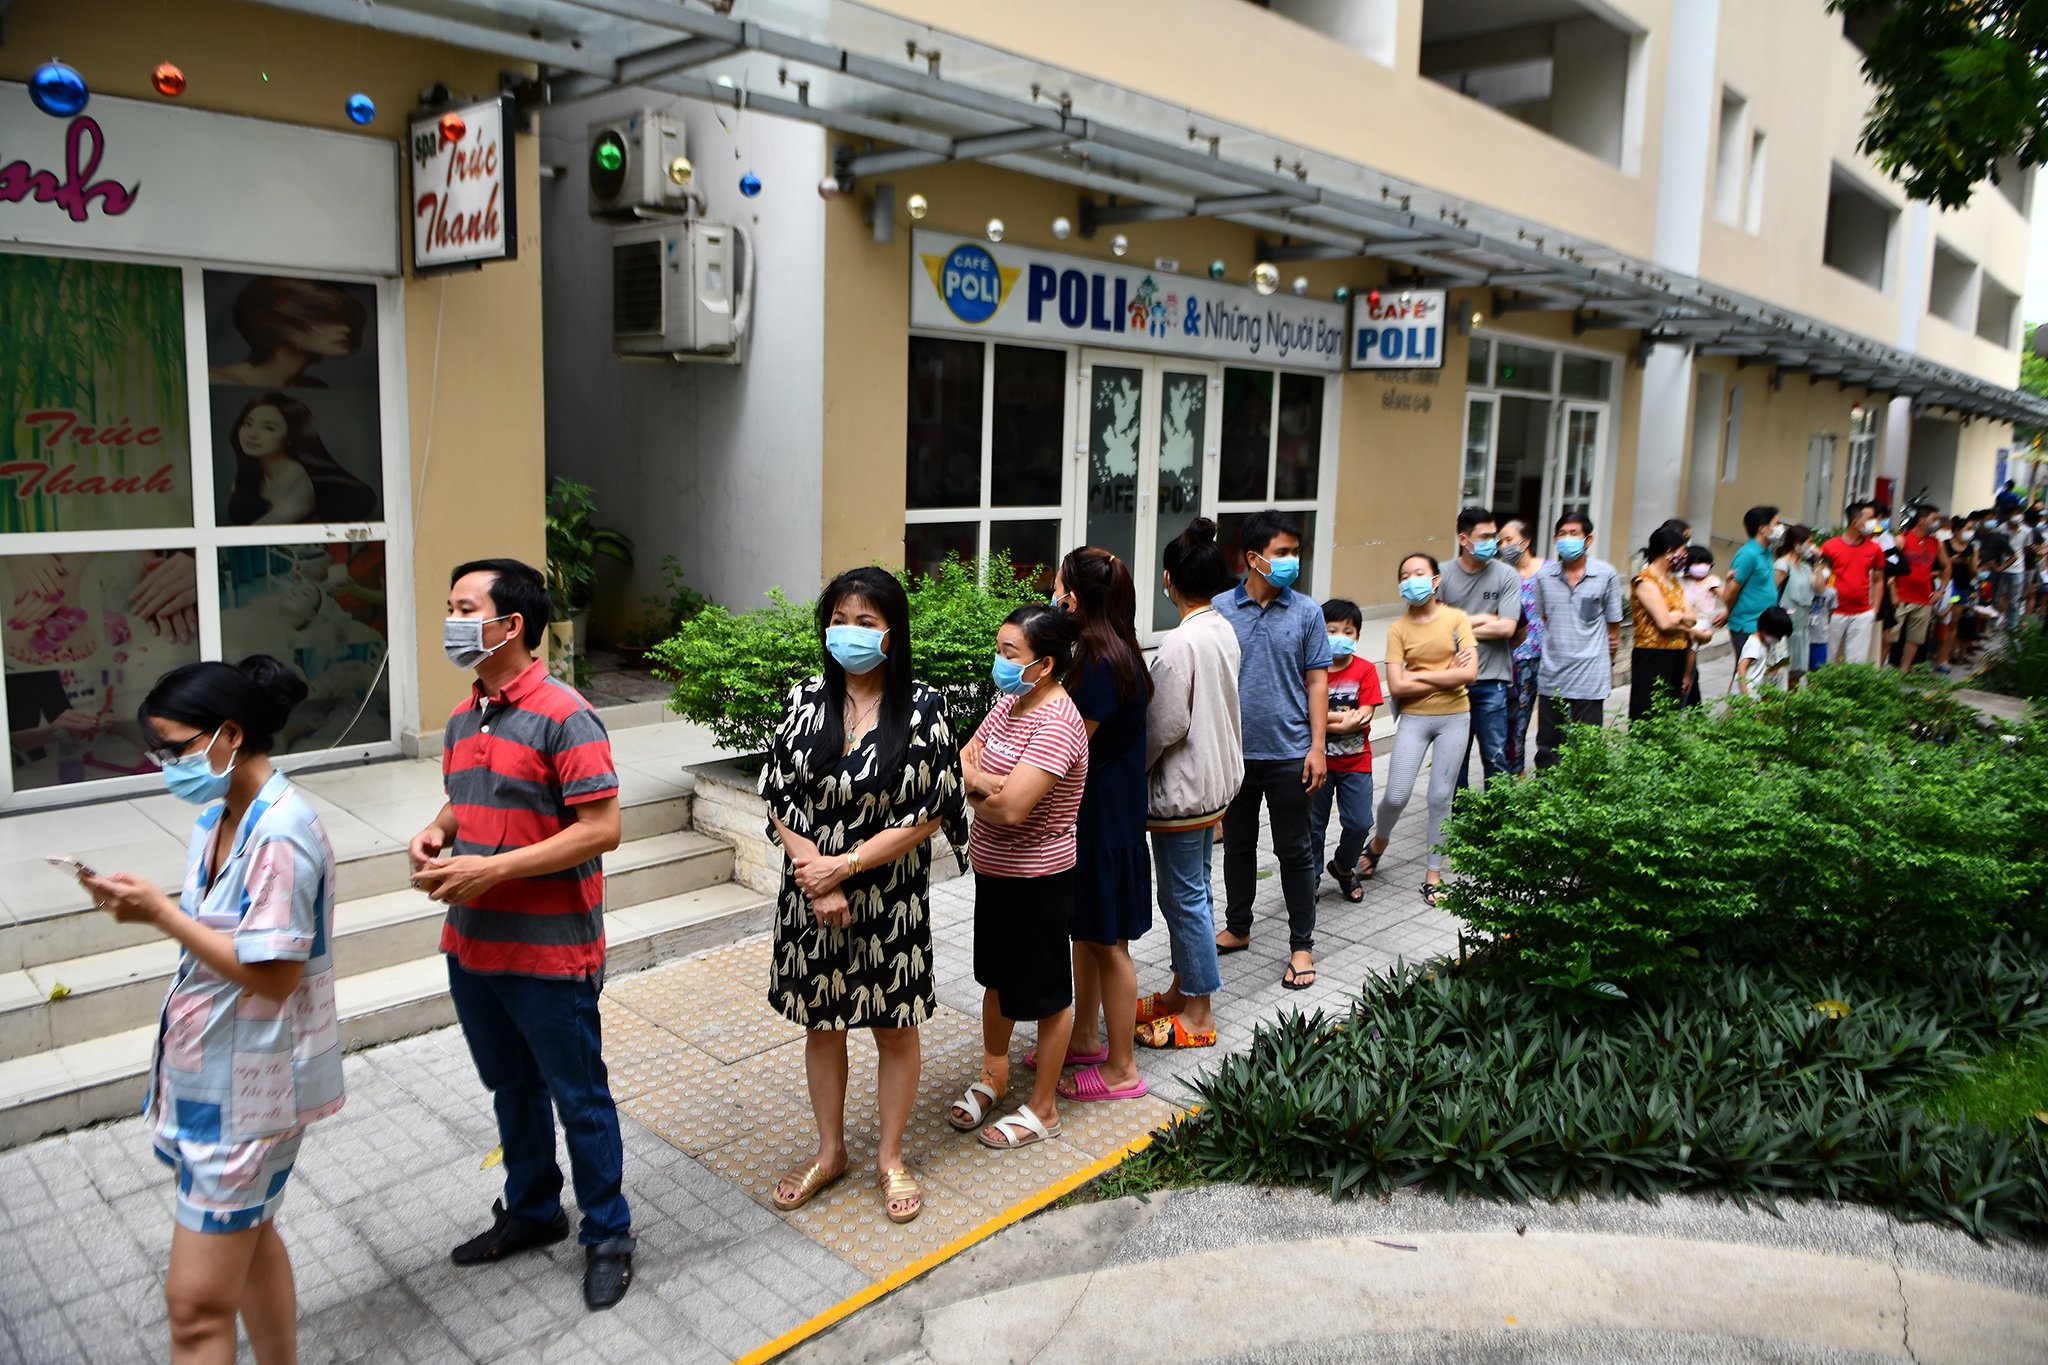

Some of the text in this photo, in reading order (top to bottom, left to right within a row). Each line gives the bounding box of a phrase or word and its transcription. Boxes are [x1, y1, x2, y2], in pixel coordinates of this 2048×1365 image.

[415, 132, 437, 168] spa
[417, 182, 499, 255] Thanh
[953, 254, 990, 271] CAFÉ
[946, 271, 999, 304] POLI
[1027, 263, 1128, 334] POLI
[1183, 296, 1201, 337] &
[1357, 326, 1436, 361] POLI
[25, 409, 163, 447] Trúc
[0, 462, 175, 497] Thanh
[1483, 591, 1499, 600] 89
